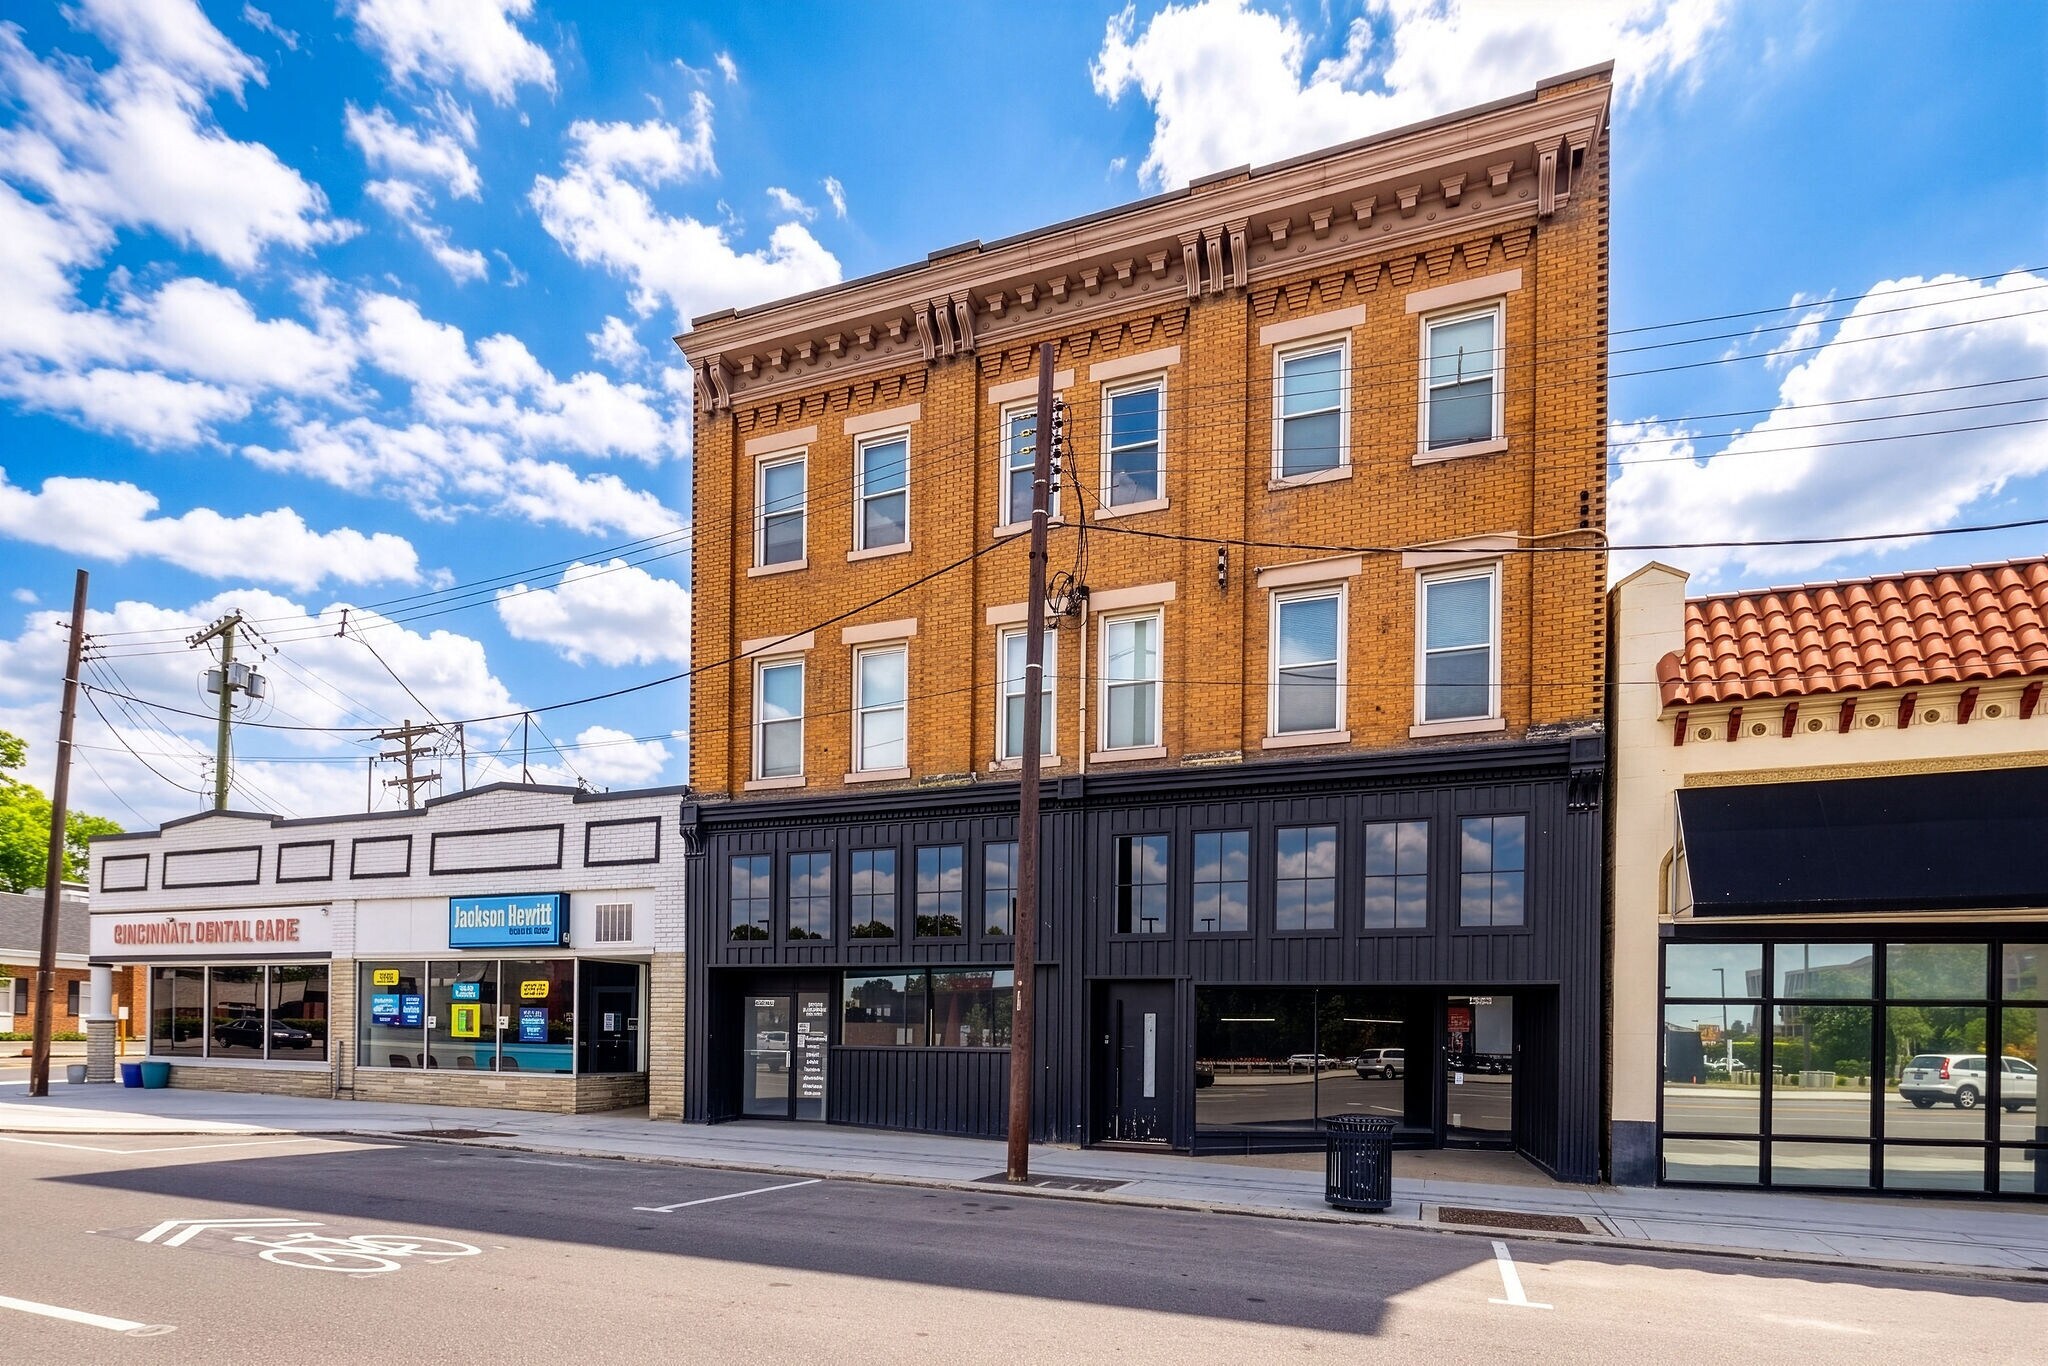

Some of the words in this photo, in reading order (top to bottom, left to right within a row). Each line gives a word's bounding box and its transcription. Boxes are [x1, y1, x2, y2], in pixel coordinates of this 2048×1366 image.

[508, 902, 552, 927] Hewitt
[195, 920, 253, 944] DENTAL
[255, 918, 300, 942] CARE
